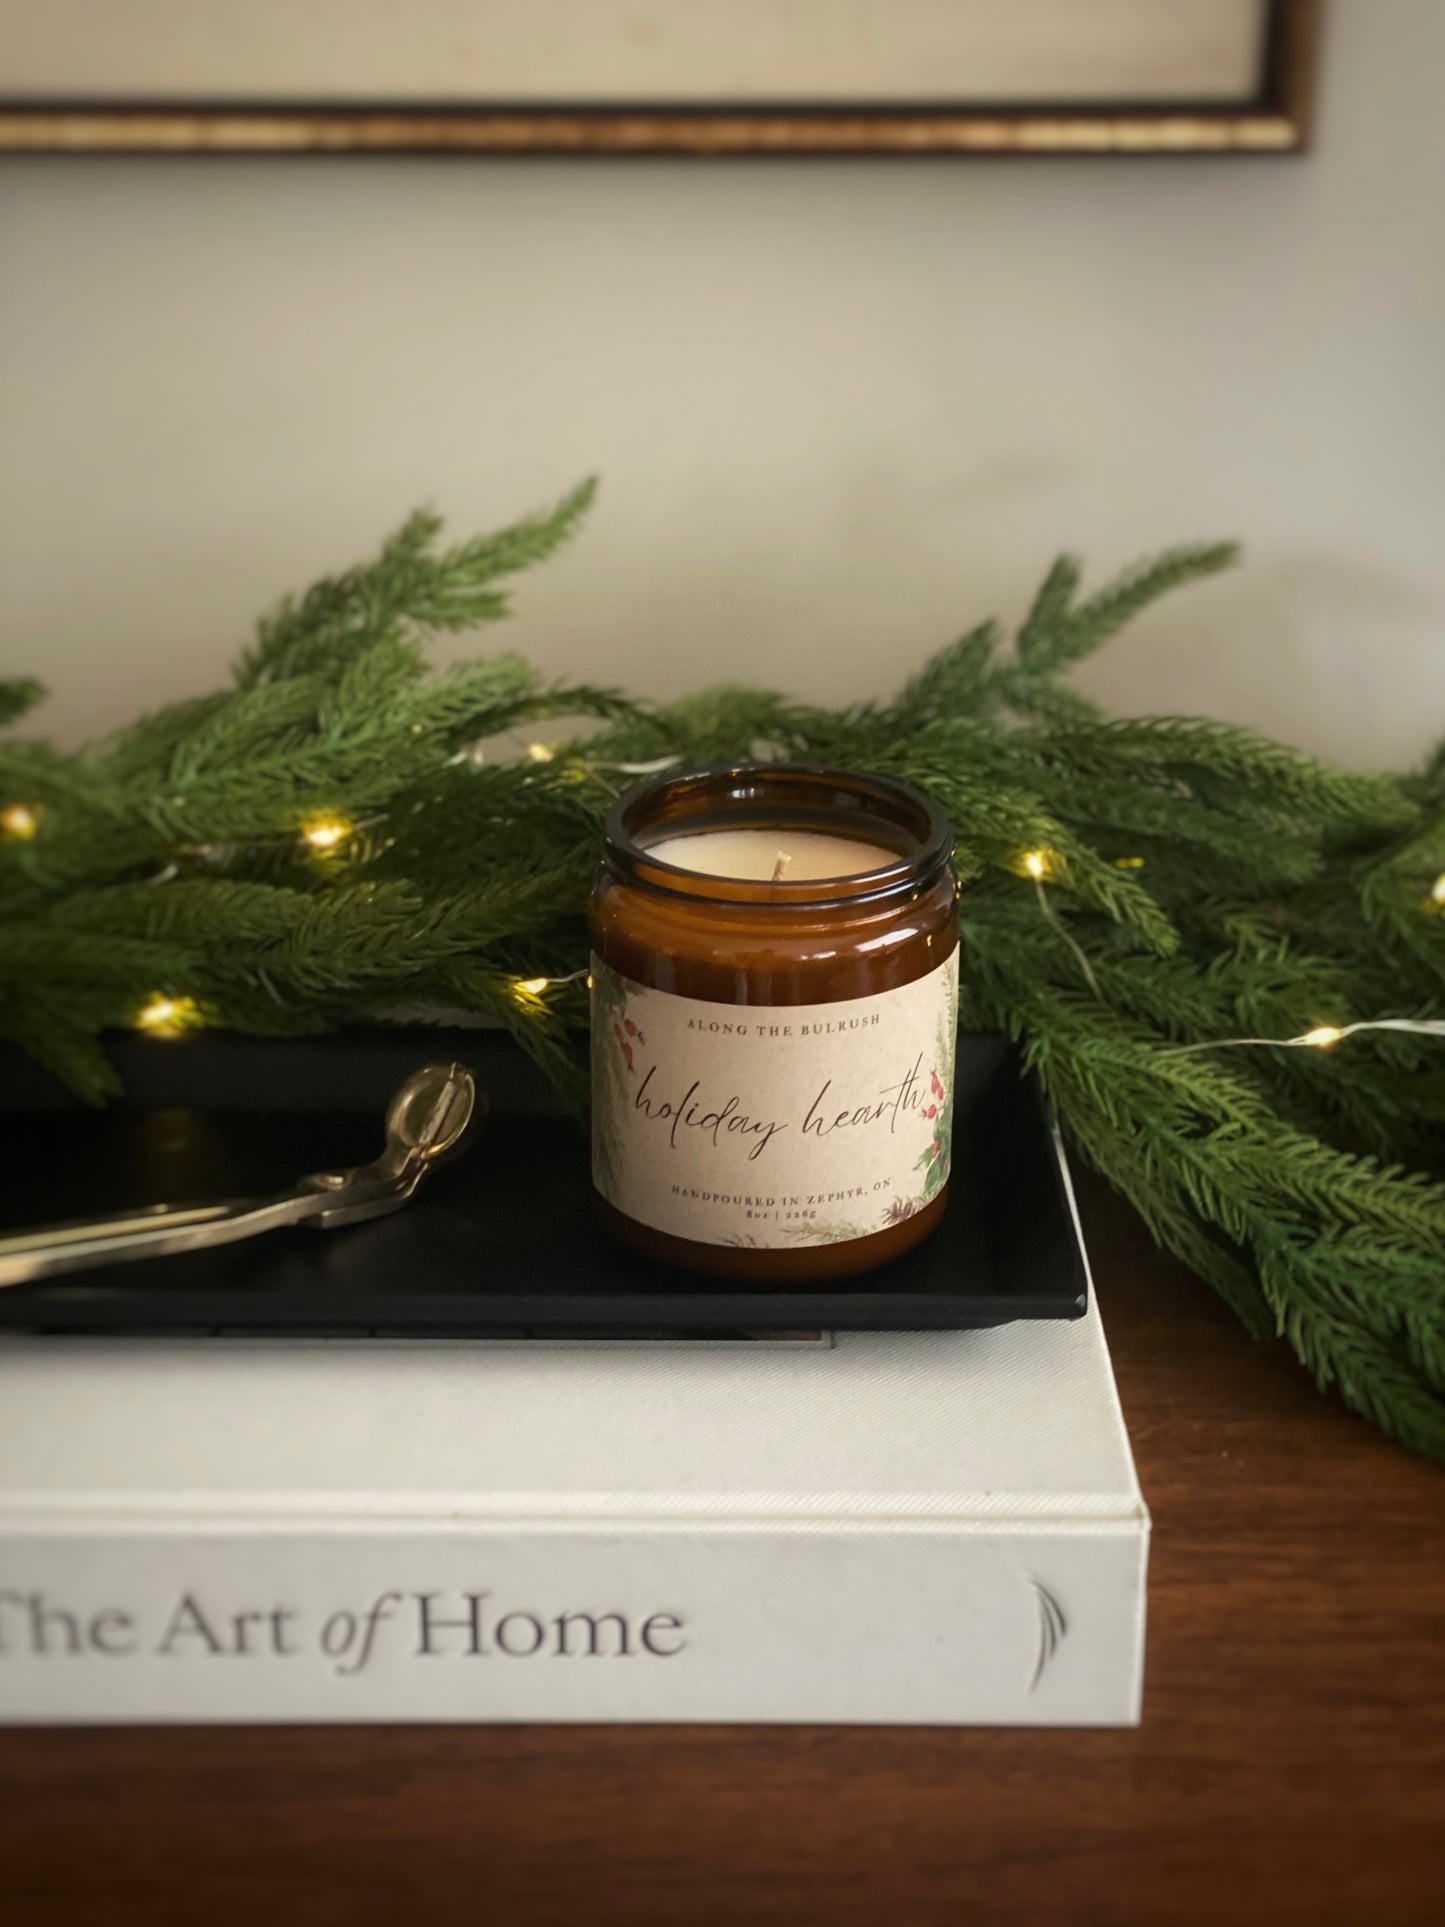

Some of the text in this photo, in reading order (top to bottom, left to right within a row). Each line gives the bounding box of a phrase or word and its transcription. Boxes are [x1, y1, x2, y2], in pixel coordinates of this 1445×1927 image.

[687, 1014, 880, 1036] ALONG THE BULRUSH
[634, 1052, 926, 1160] holiday hearth
[671, 1185, 775, 1207] HANDPOURED
[782, 1196, 800, 1207] IN
[873, 1177, 892, 1193] ON
[157, 1591, 300, 1656] Art
[320, 1592, 403, 1675] of
[411, 1592, 687, 1657] Home
